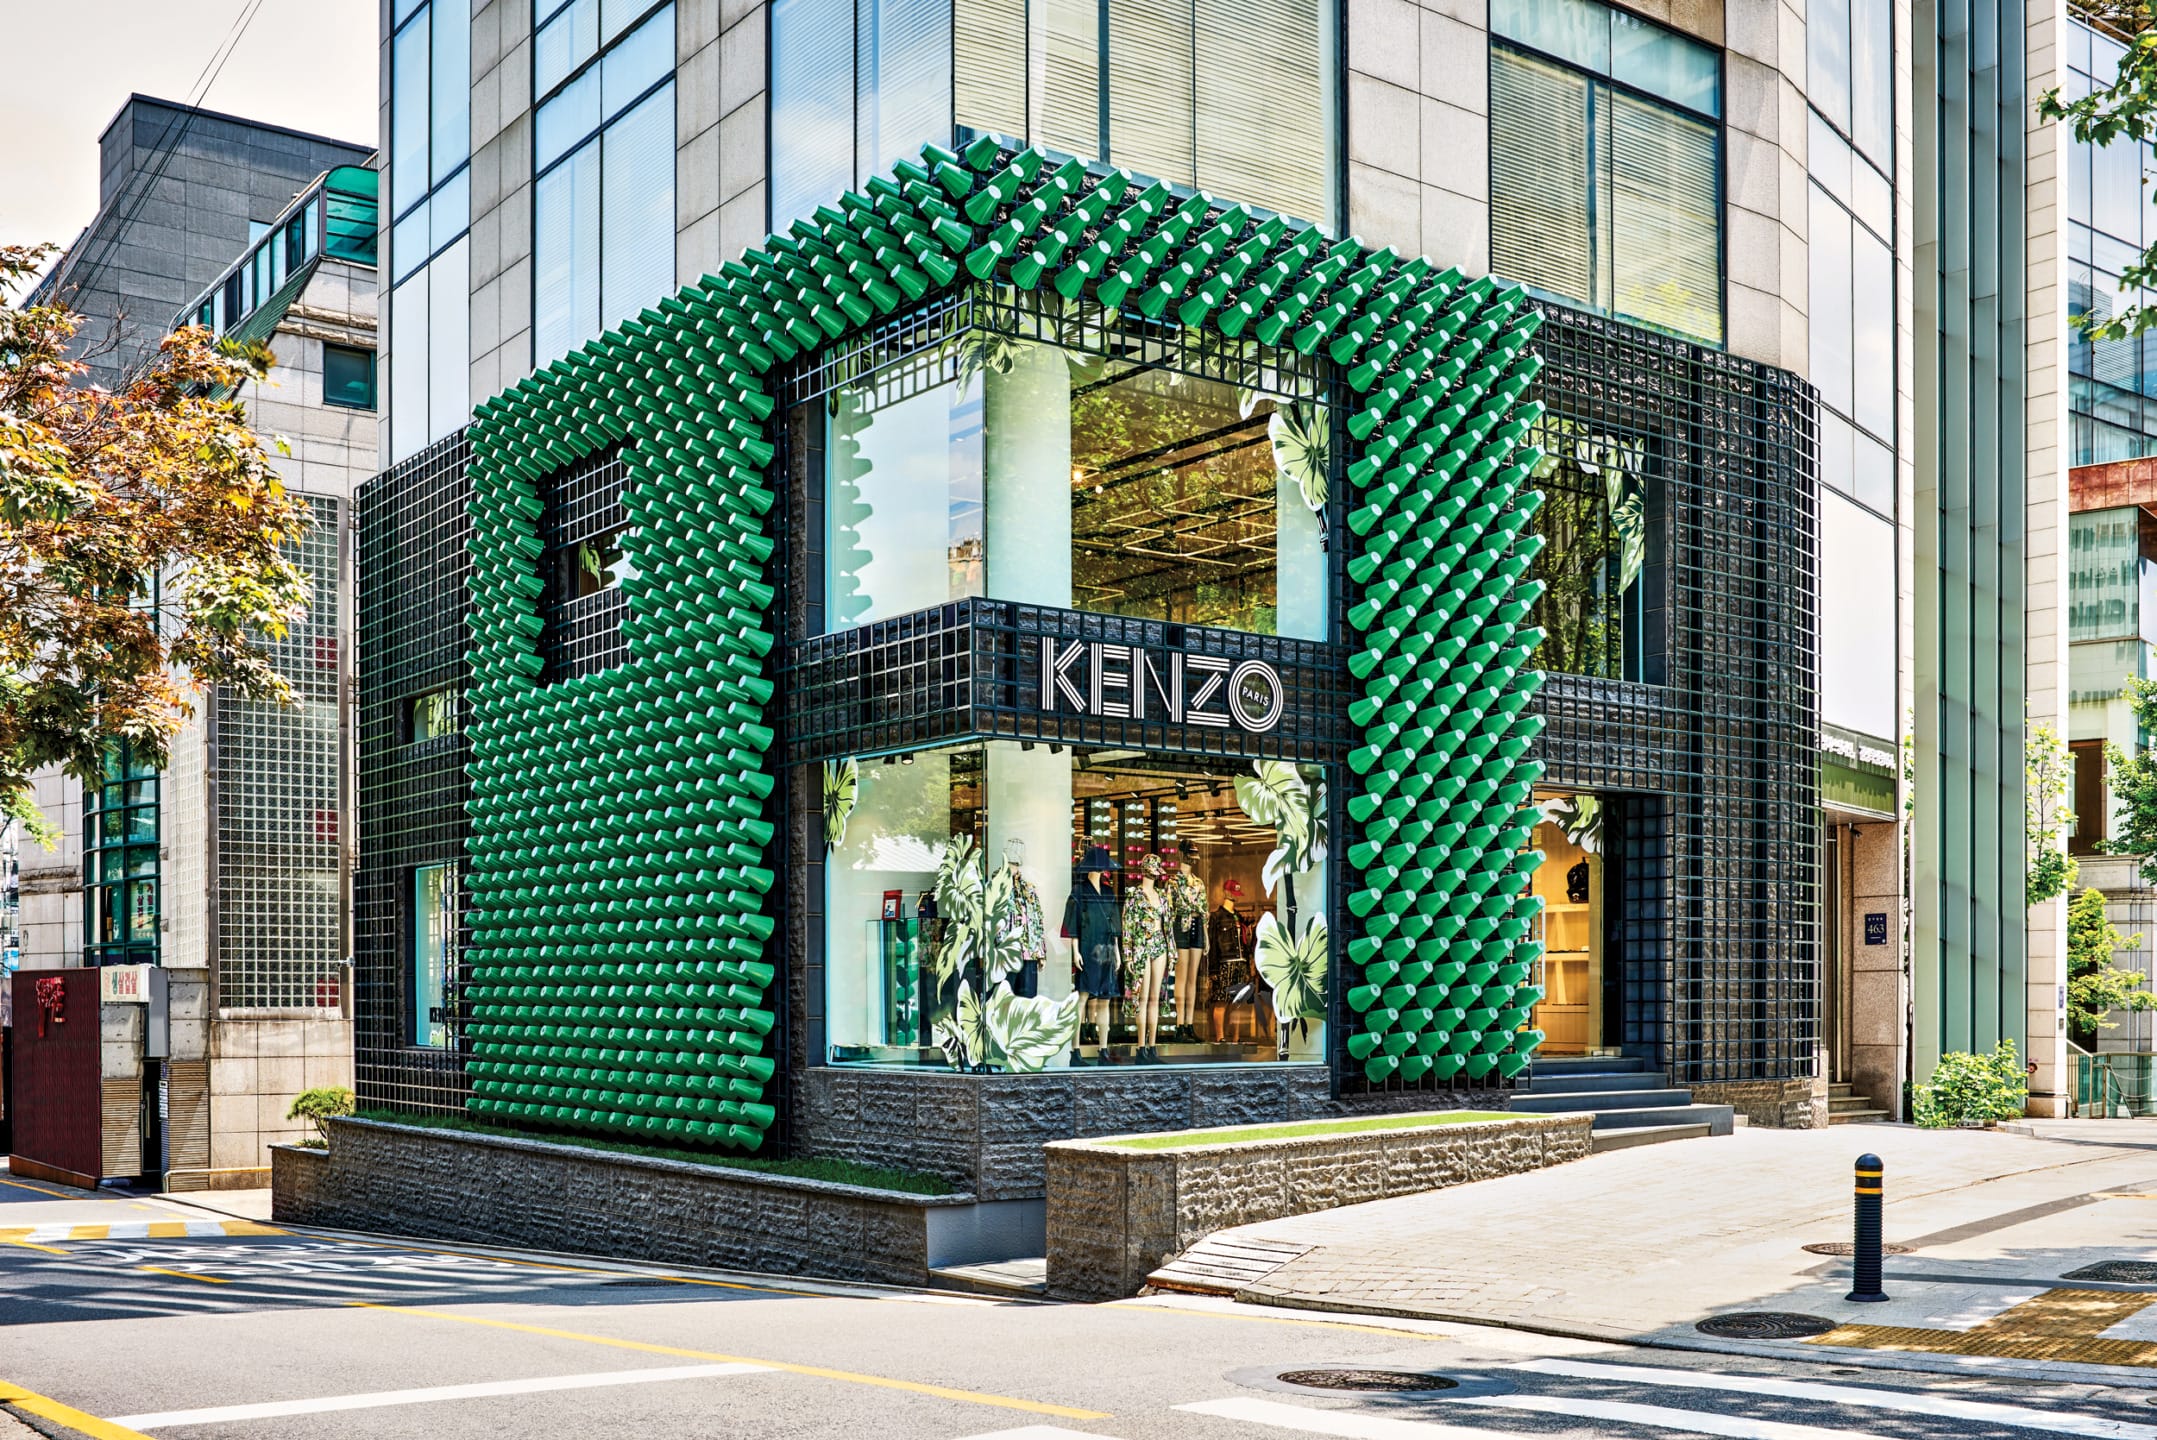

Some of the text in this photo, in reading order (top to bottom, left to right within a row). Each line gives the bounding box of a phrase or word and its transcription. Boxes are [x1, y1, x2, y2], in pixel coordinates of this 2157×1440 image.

[1042, 637, 1284, 733] KENZO
[1242, 686, 1270, 707] PARIS
[1867, 923, 1885, 934] 463
